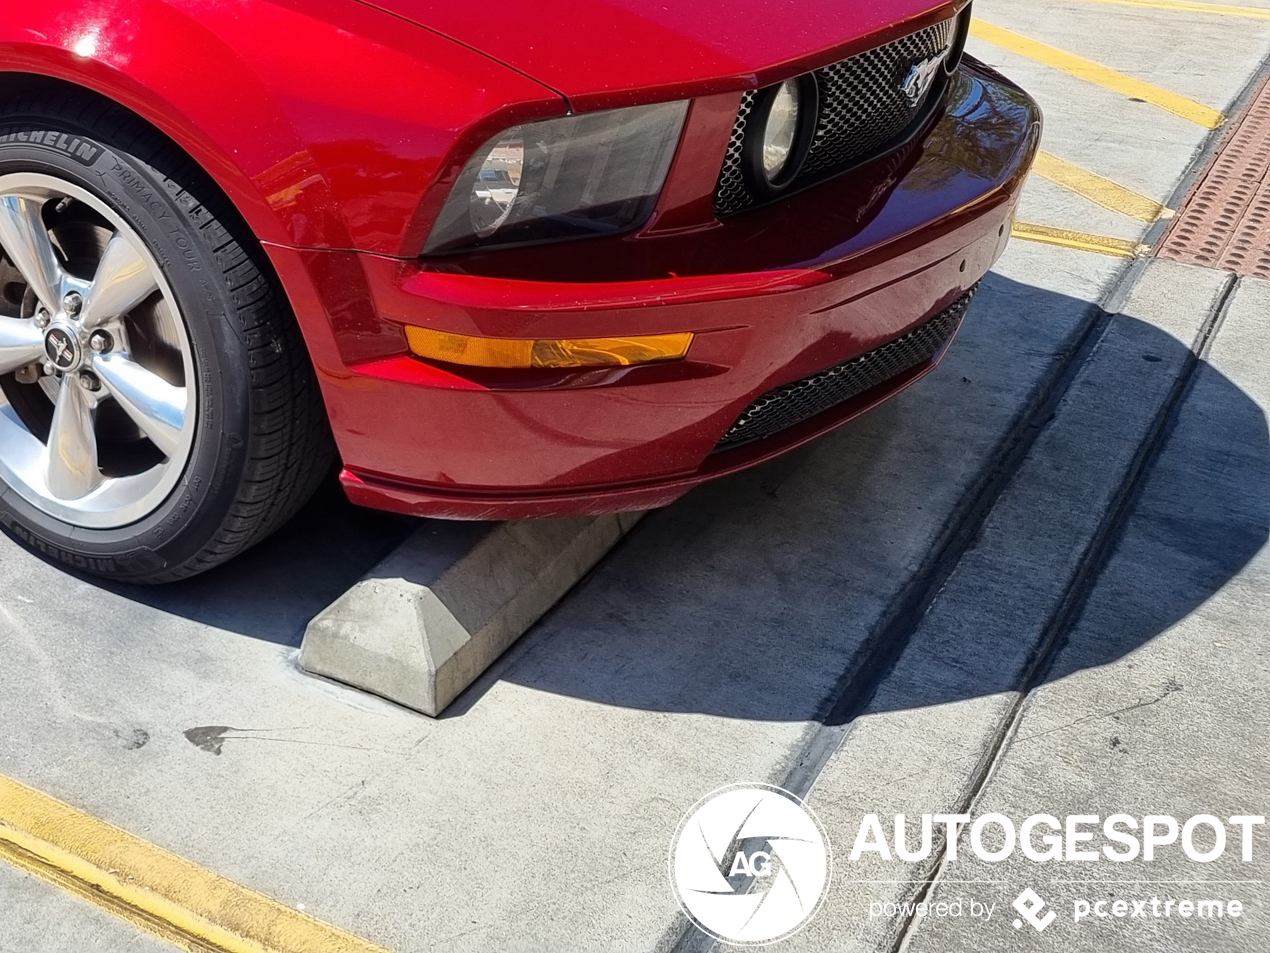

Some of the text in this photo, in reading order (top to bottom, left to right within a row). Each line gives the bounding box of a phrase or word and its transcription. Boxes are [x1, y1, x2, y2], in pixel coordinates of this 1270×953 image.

[111, 163, 171, 221] PRIMACY
[170, 225, 201, 272] TOUR
[14, 526, 117, 573] MICHELIN
